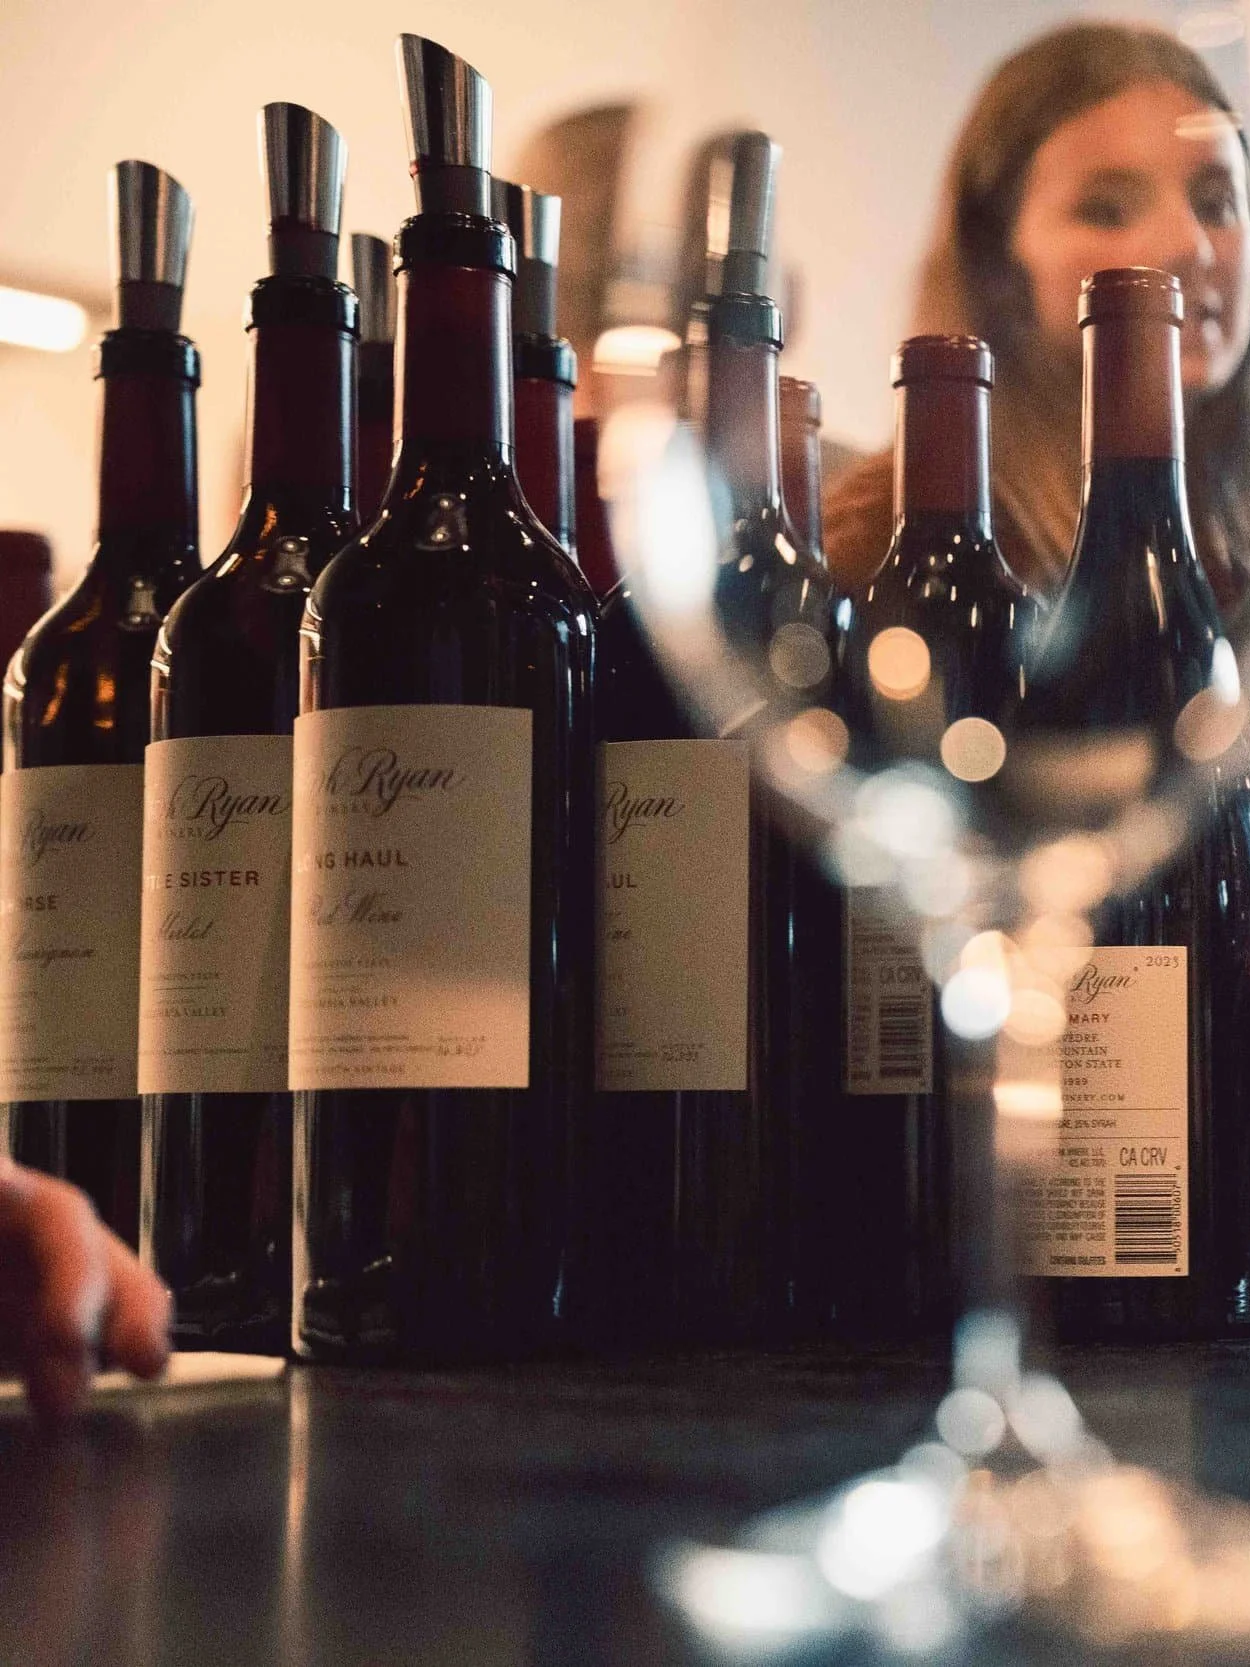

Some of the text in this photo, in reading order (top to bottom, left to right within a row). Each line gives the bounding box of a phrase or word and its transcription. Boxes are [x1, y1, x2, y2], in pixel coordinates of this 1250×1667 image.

[355, 747, 466, 817] Ryan
[186, 776, 290, 841] Ryan
[605, 780, 686, 845] Ryan
[344, 849, 409, 868] HAUL
[180, 870, 260, 888] SISTER
[24, 895, 60, 912] RSE
[1146, 956, 1179, 969] 2023
[1070, 963, 1137, 1005] Ryan
[1068, 1012, 1111, 1026] MARY
[1085, 1059, 1122, 1069] STATE
[1120, 1147, 1137, 1167] CA
[1140, 1147, 1167, 1167] CRV
